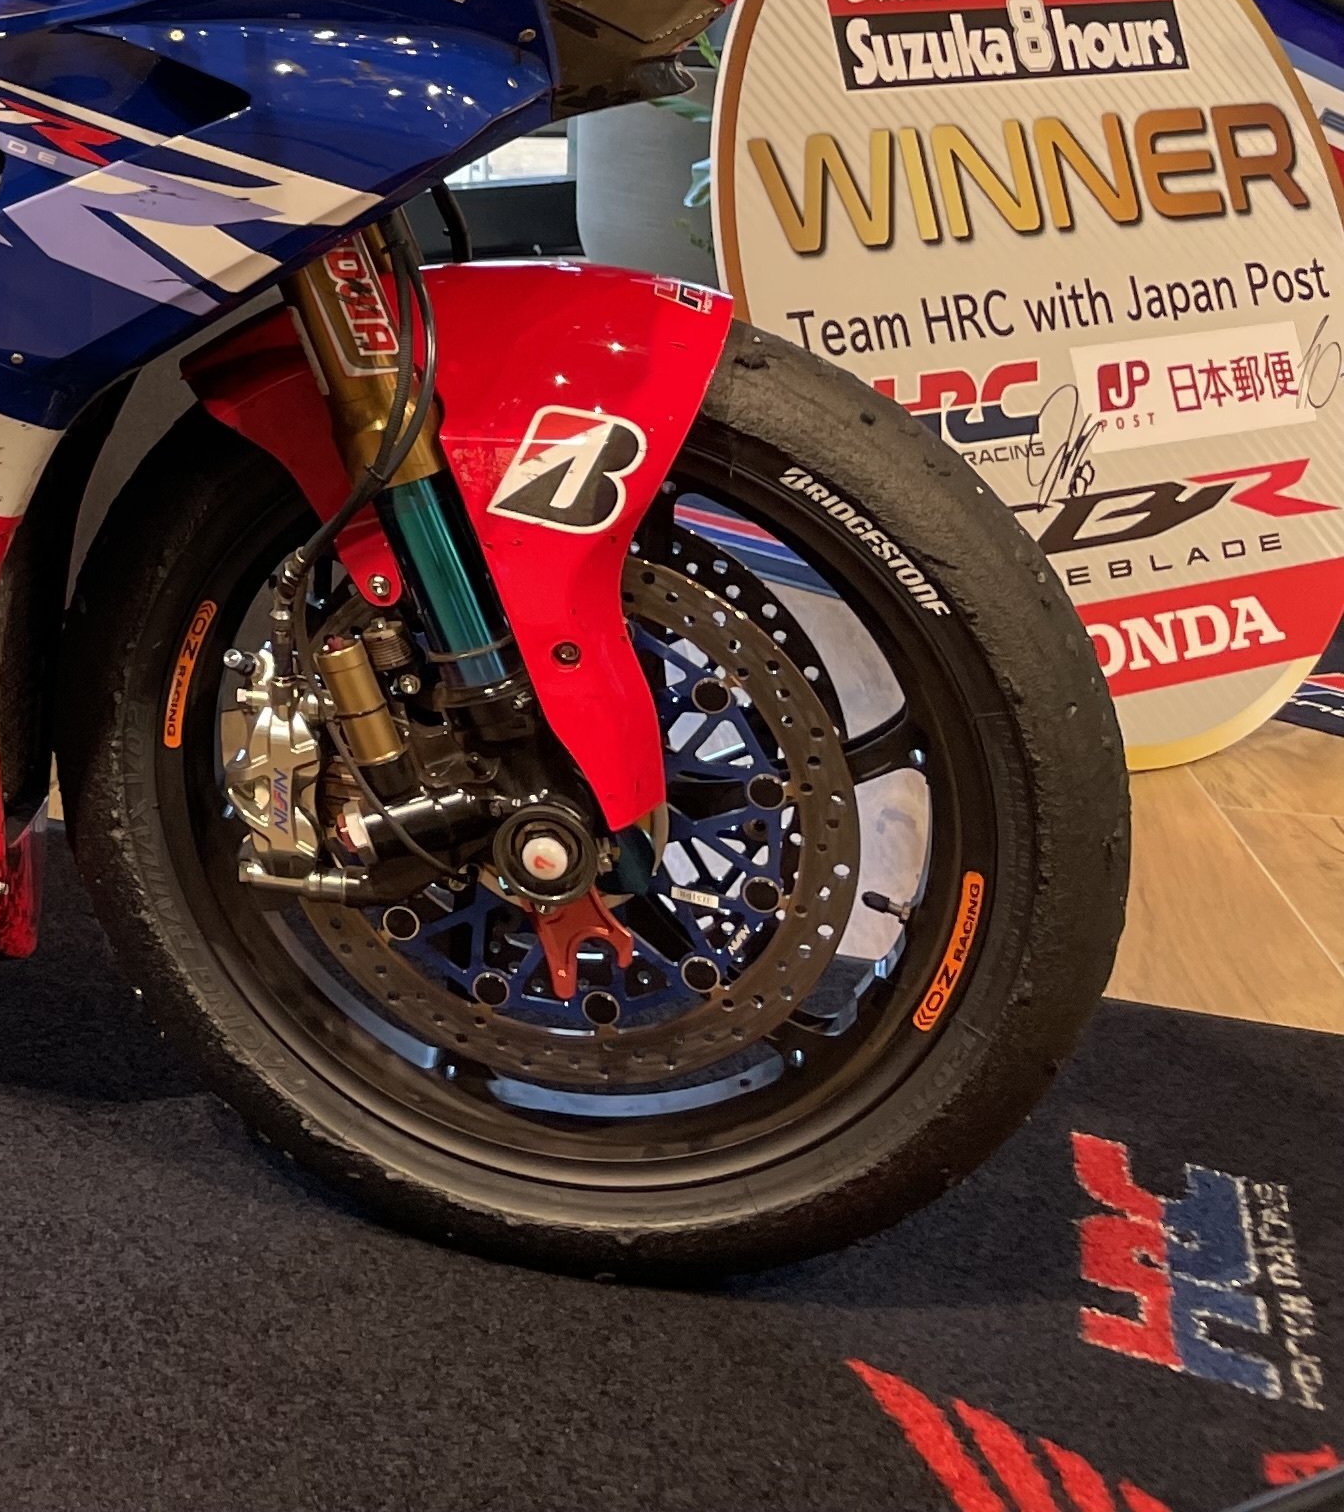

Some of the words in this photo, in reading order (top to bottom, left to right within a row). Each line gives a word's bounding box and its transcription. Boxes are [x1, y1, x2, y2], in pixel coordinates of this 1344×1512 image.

[845, 13, 1017, 86] Suzuka
[1050, 8, 1176, 71] hours
[747, 102, 1311, 255] WINNER
[786, 310, 910, 358] Team
[920, 289, 1016, 345] HRC
[1023, 277, 1113, 332] with
[1127, 274, 1237, 322] Japan
[1244, 257, 1331, 306] Post
[1166, 350, 1300, 413] 日本郵便
[1099, 411, 1155, 433] POST
[1066, 532, 1283, 587] EBLADE
[167, 665, 186, 737] RACING
[953, 883, 981, 962] RACING
